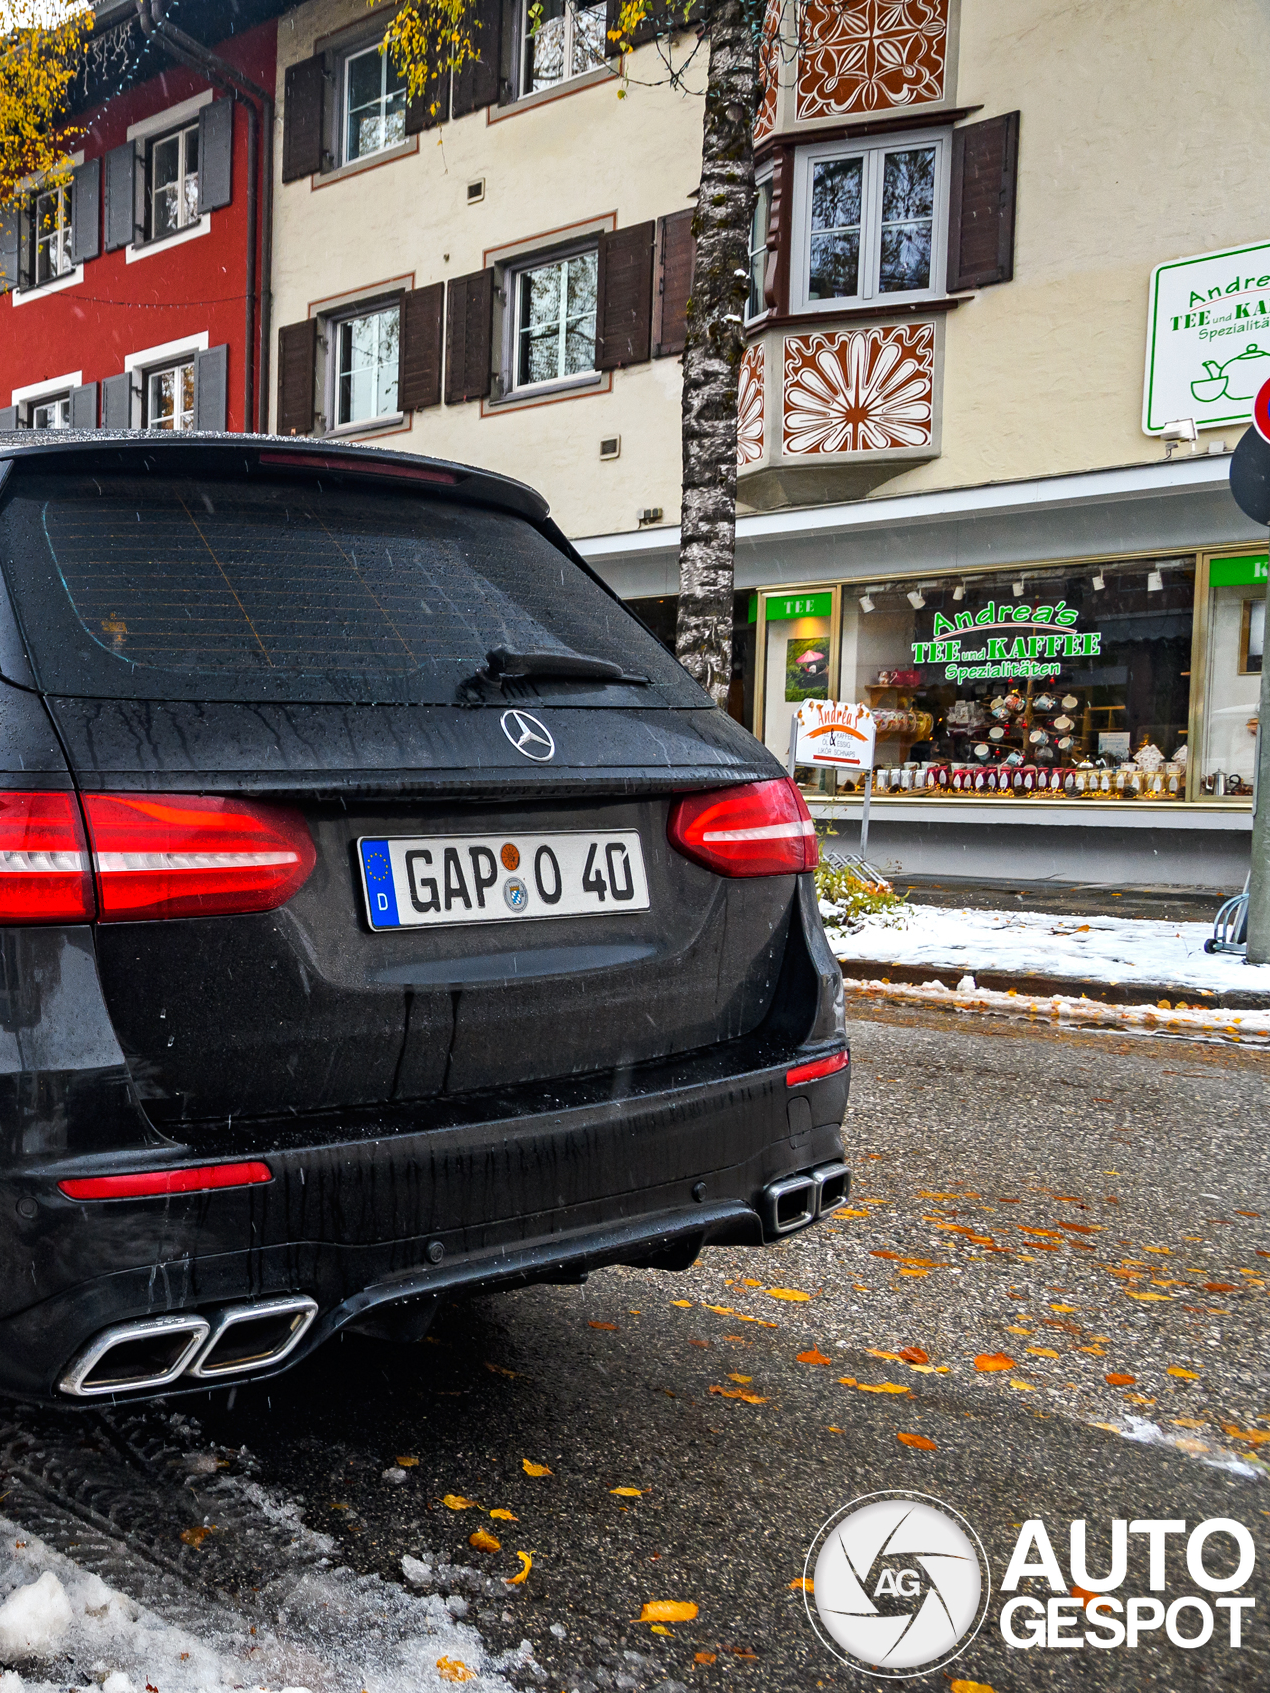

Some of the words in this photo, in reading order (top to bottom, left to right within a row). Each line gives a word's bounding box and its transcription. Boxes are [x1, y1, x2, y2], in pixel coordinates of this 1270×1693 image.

[1170, 310, 1211, 332] TEE
[1212, 313, 1232, 325] und
[1235, 299, 1270, 319] KA
[1198, 316, 1270, 342] Spezialitä
[784, 600, 815, 614] TEE
[933, 601, 1079, 636] Andrea's
[912, 641, 961, 663] TEE
[962, 648, 986, 662] und
[986, 632, 1101, 660] KAFFEE
[945, 661, 1061, 685] Spezialitäten
[830, 727, 837, 747] &
[405, 846, 498, 913] GAP
[534, 845, 562, 905] O
[582, 842, 635, 902] 40
[377, 892, 389, 911] D
